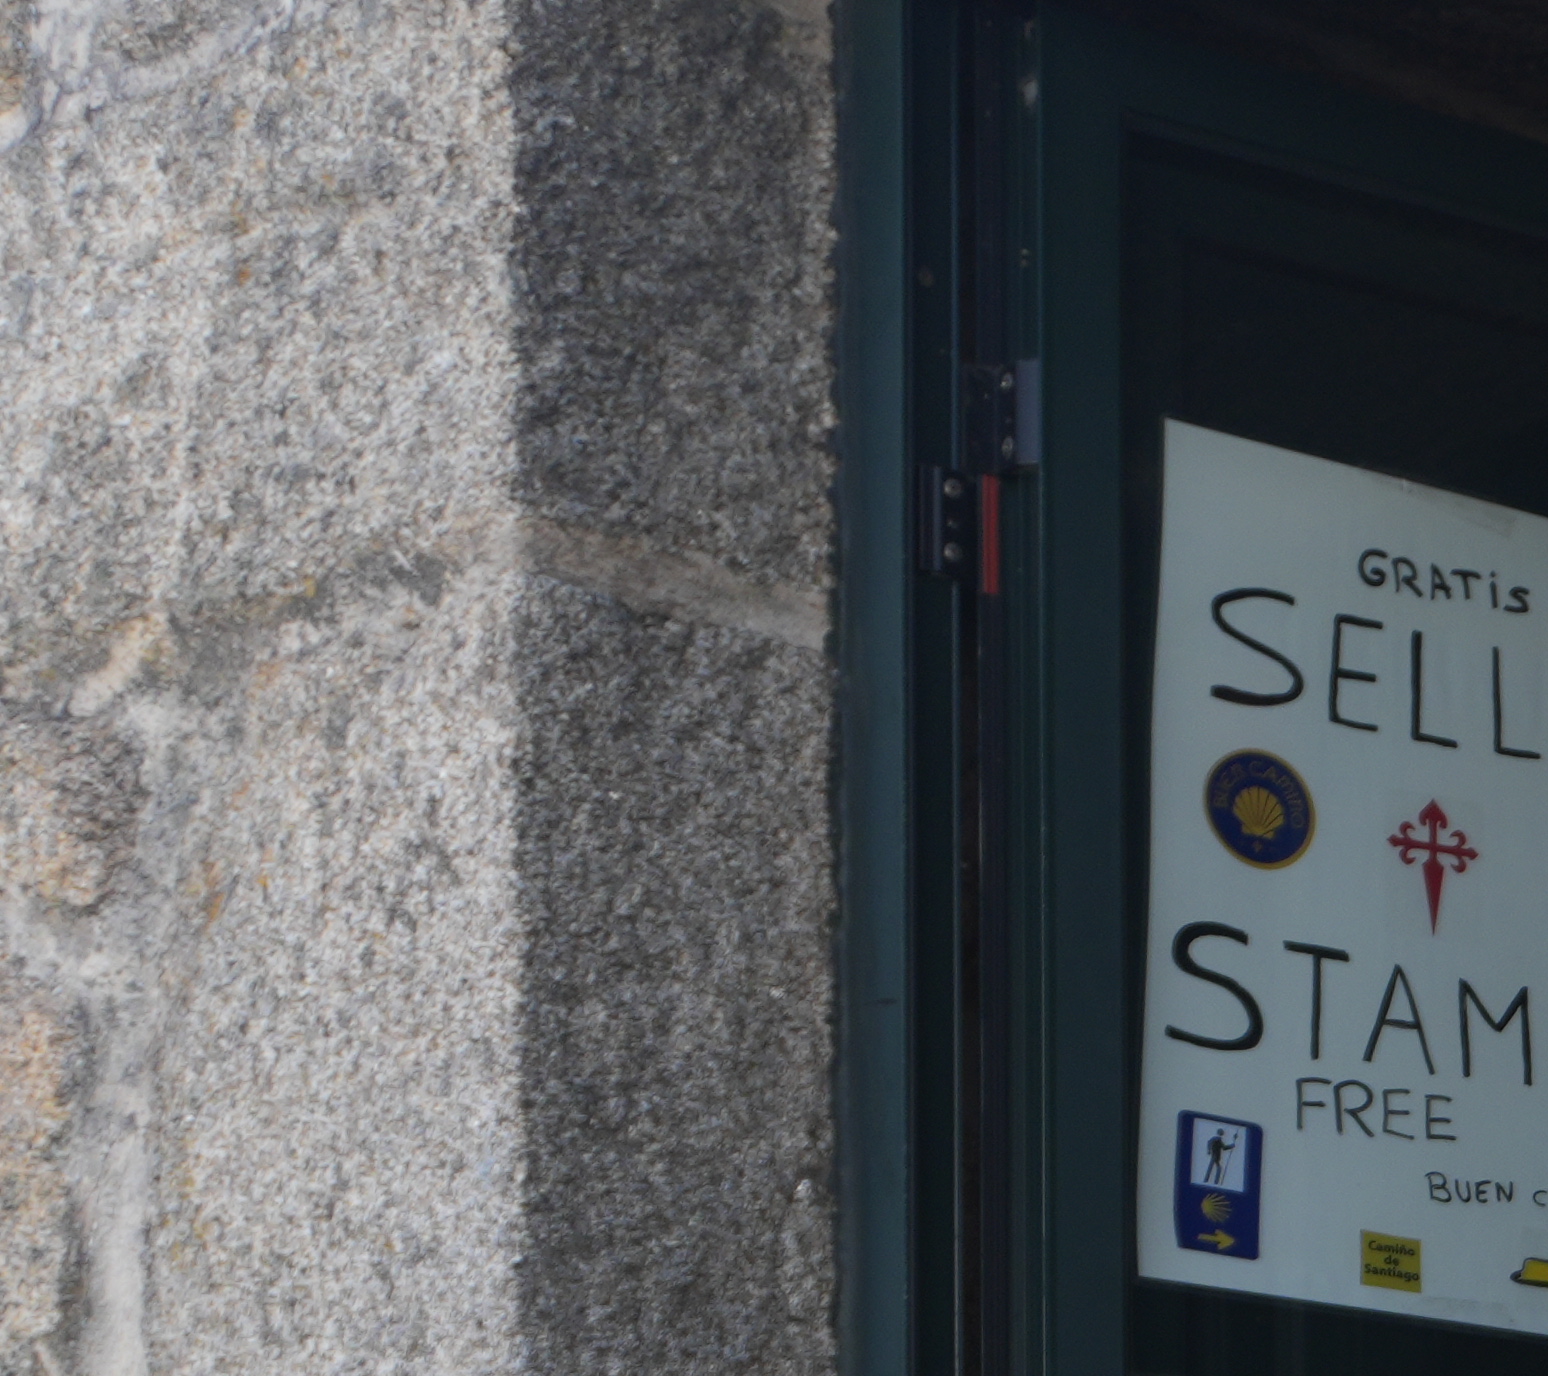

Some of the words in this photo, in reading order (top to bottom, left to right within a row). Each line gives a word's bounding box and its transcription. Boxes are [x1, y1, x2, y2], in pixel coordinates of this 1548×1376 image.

[1295, 1076, 1458, 1142] FREE
[1425, 1171, 1514, 1204] BUEN
[1364, 1263, 1420, 1282] Santiago
[1384, 1254, 1399, 1266] de
